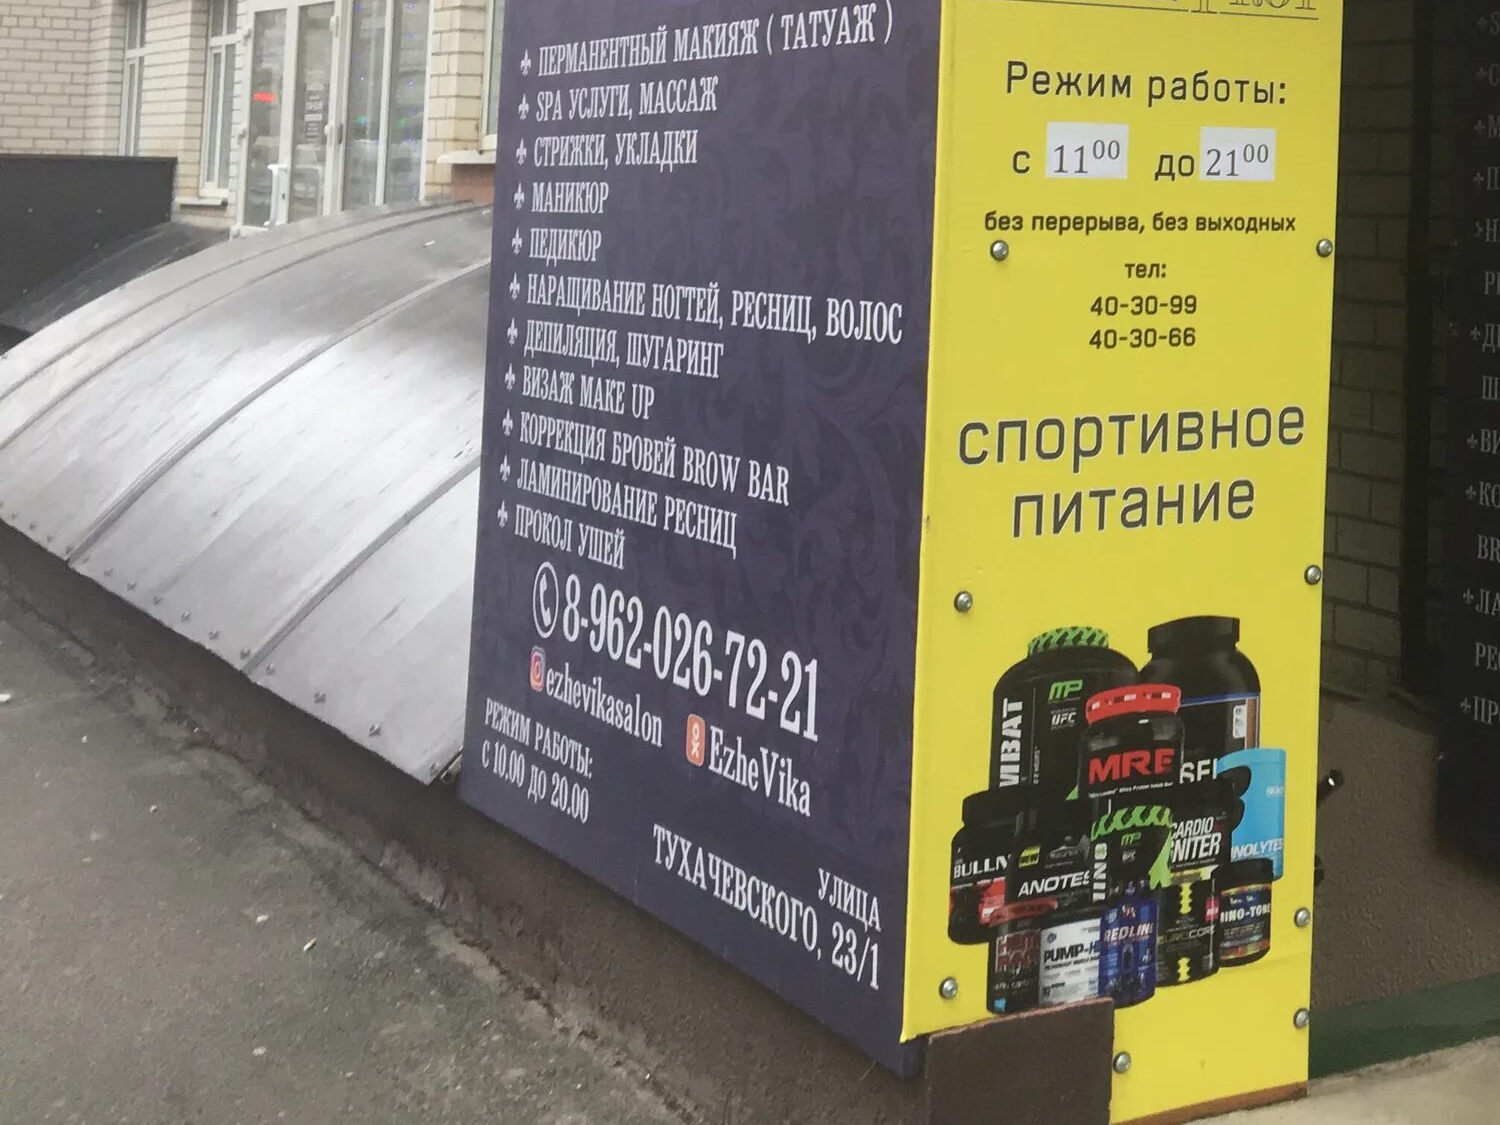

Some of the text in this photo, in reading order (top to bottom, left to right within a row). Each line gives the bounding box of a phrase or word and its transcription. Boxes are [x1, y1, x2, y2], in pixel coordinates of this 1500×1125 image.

[538, 25, 668, 76] ПЕРМАНЕНТНЫЙ
[673, 18, 760, 63] МАКИЯЖ
[536, 76, 718, 122] SPA УСЛУГИ, МАССАЖ
[1006, 60, 1286, 107] Режим работы:
[534, 129, 698, 173] СТРИЖКИ, УКЛАДКИ
[1013, 151, 1030, 174] с
[1155, 154, 1194, 181] до
[531, 182, 609, 214] МАНИКЮР
[984, 211, 1296, 235] без перерыва, без выходных
[529, 227, 602, 266] ПЕДИКЮР
[1125, 262, 1167, 279] тел:
[527, 273, 902, 344] НАРАЩИВАНИЕ НОГТЕЙ, РЕСНИЦ, ВОЛОС
[1090, 295, 1197, 316] 40-30-99
[524, 319, 724, 378] ДЕПИЛЯЦИЯ, ШУГАРИНГ
[1089, 327, 1196, 349] 40-30-66
[522, 365, 655, 420] ВИЗАЖ MAKE UP
[519, 411, 789, 506] КОРРЕКЦИЯ БРОВЕЙ BROW BAR
[959, 406, 1304, 473] спортивное
[515, 505, 625, 570] ПРОКОЛ УШЕЙ
[517, 458, 737, 559] ЛАМИНИРОВАНИЕ РЕСНИЦ
[1013, 479, 1255, 538] питание
[563, 574, 818, 742] 8-962-026-72-21
[546, 662, 663, 747] ezhevikasalon
[484, 697, 593, 780] РЕЖИМ РАБОТЫ:
[493, 743, 525, 788] 10.00
[528, 765, 547, 803] ДО
[550, 777, 589, 824] 20.00
[709, 725, 811, 817] EzheVika
[653, 824, 822, 961] ТУХАЧЕВСКОГО,
[832, 921, 879, 991] 23/1
[818, 867, 881, 932] УЛИЦА
